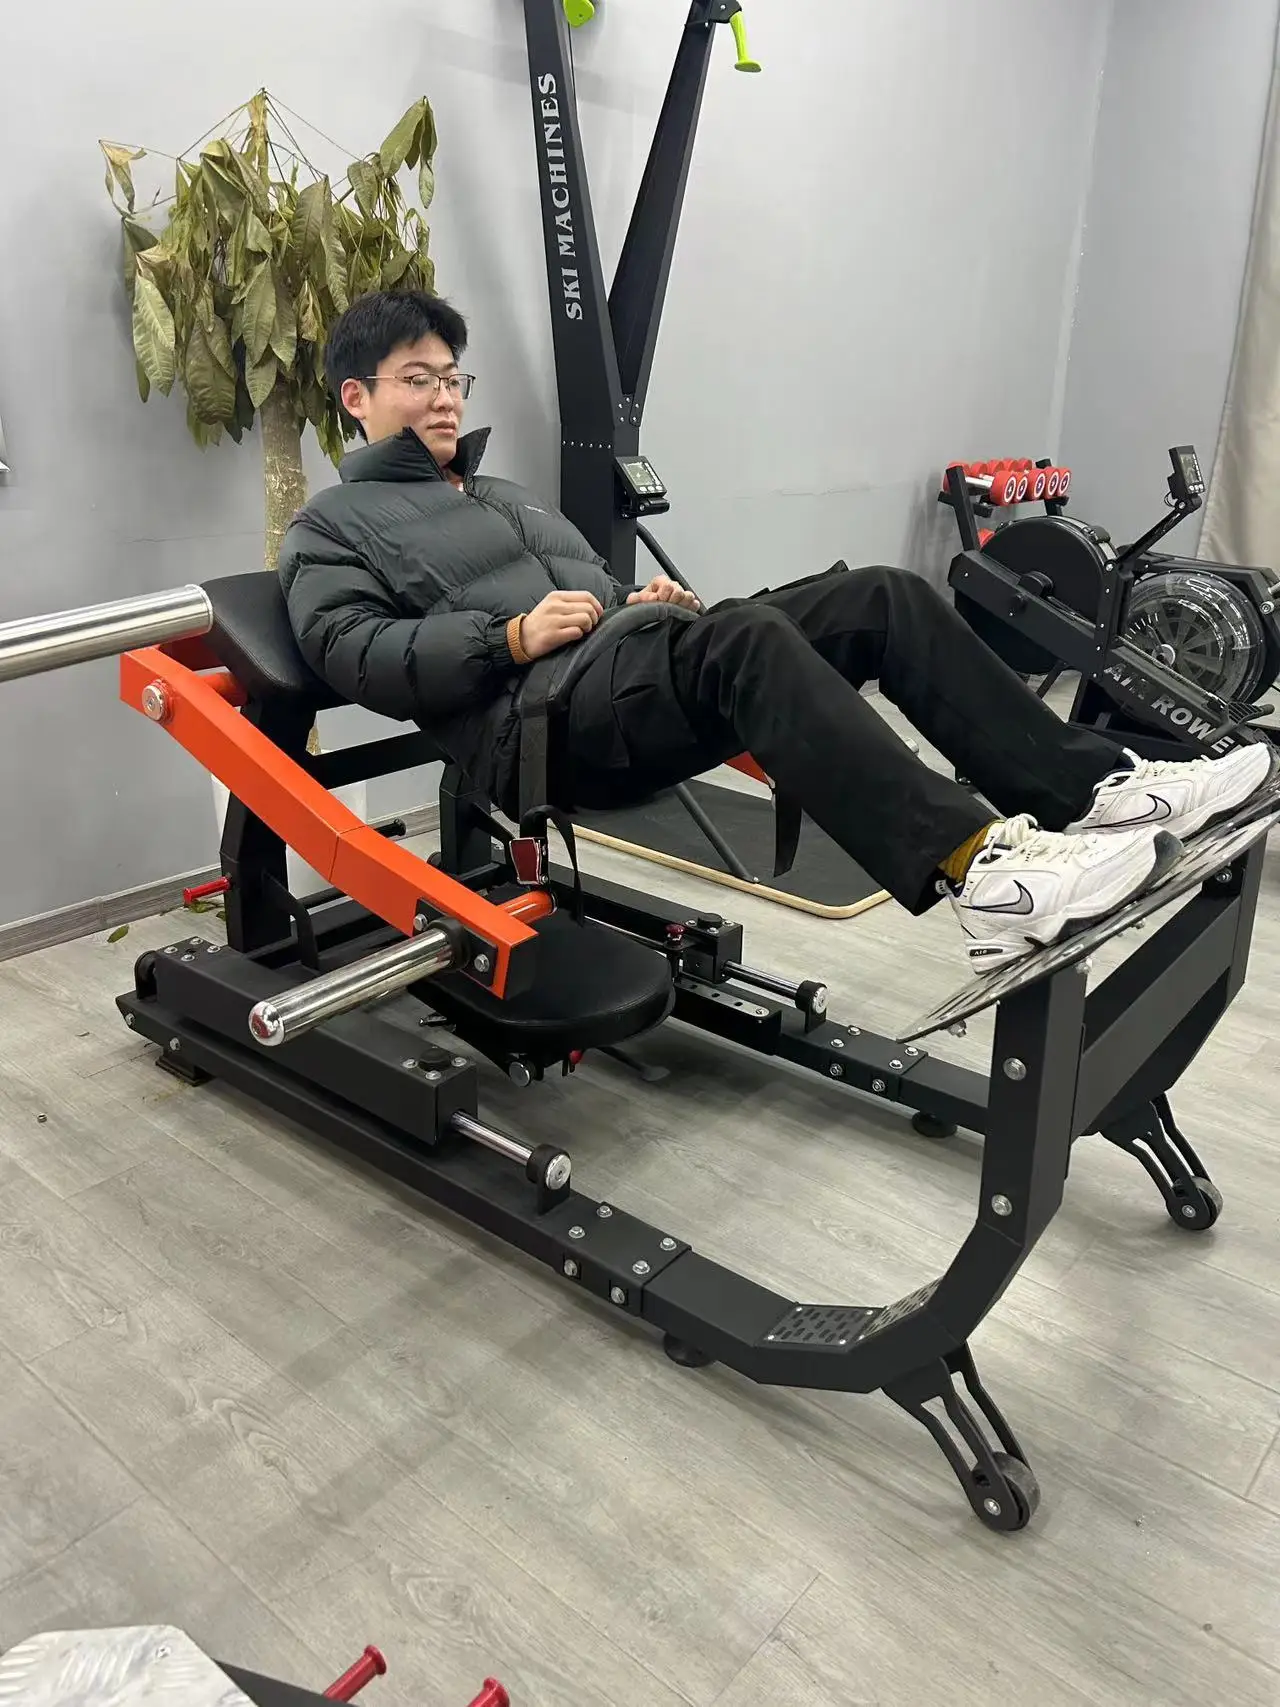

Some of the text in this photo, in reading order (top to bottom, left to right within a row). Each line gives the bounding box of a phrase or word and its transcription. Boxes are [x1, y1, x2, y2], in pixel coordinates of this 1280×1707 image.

[537, 72, 583, 321] SKI MACHINES
[1150, 694, 1243, 757] ROWE
